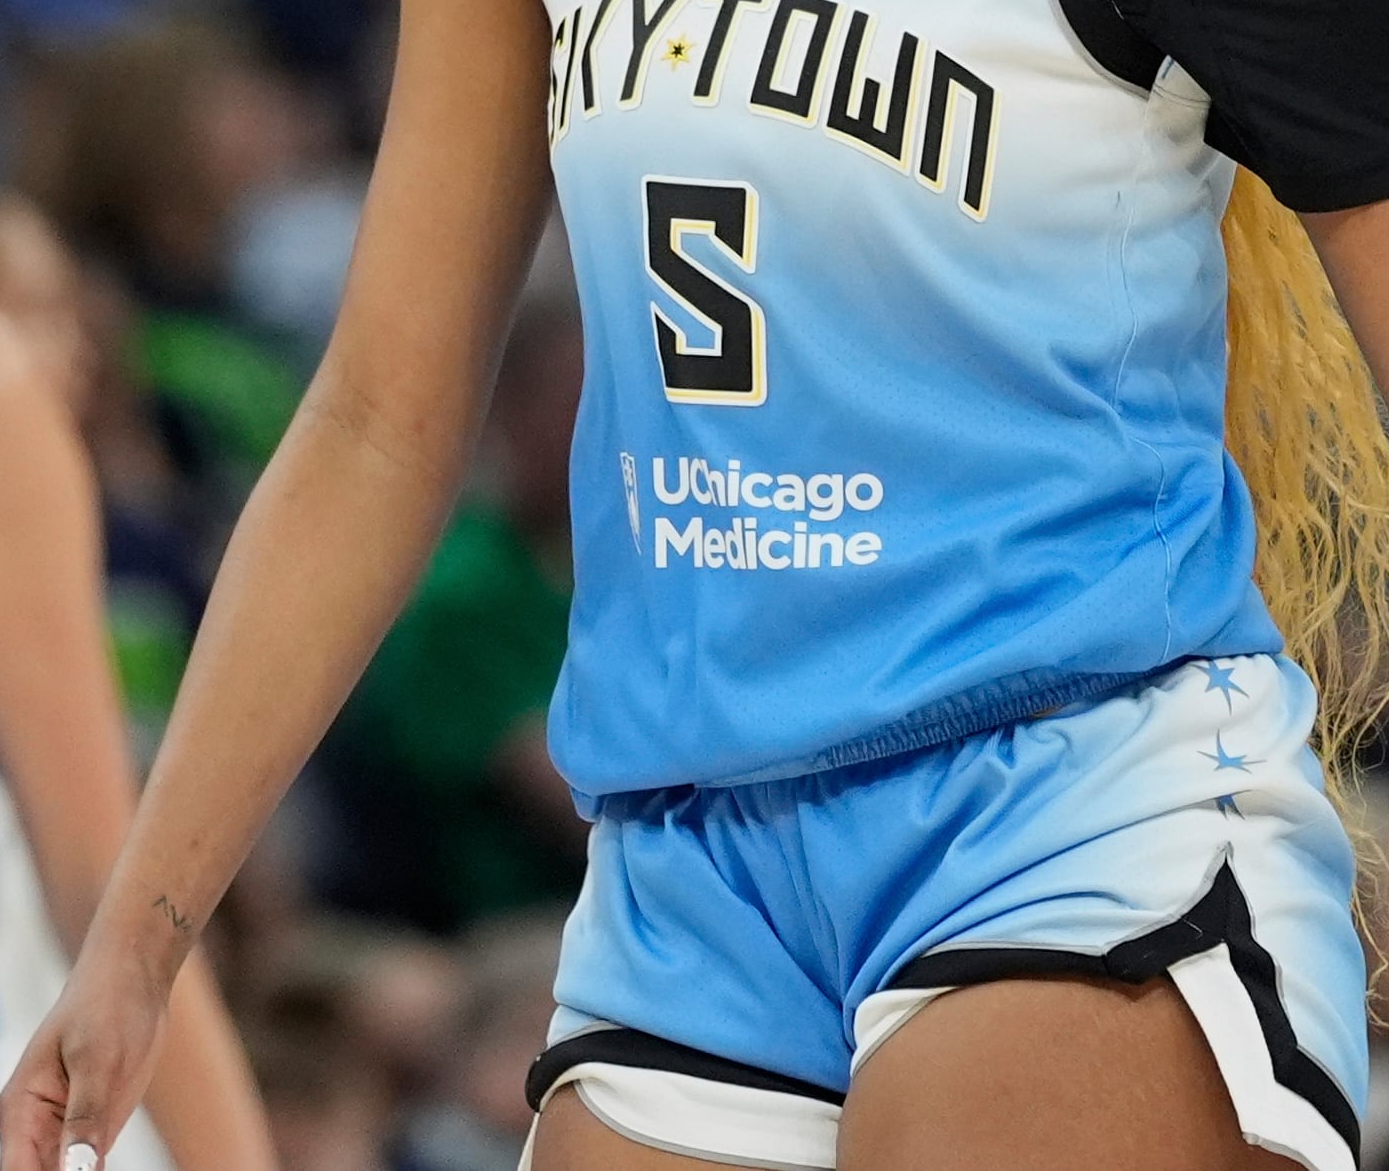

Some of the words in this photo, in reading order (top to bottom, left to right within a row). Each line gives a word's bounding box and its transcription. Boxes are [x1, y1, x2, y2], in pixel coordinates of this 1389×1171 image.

[642, 175, 767, 407] 5
[652, 456, 884, 522] UChicago
[654, 516, 883, 570] Medicine
